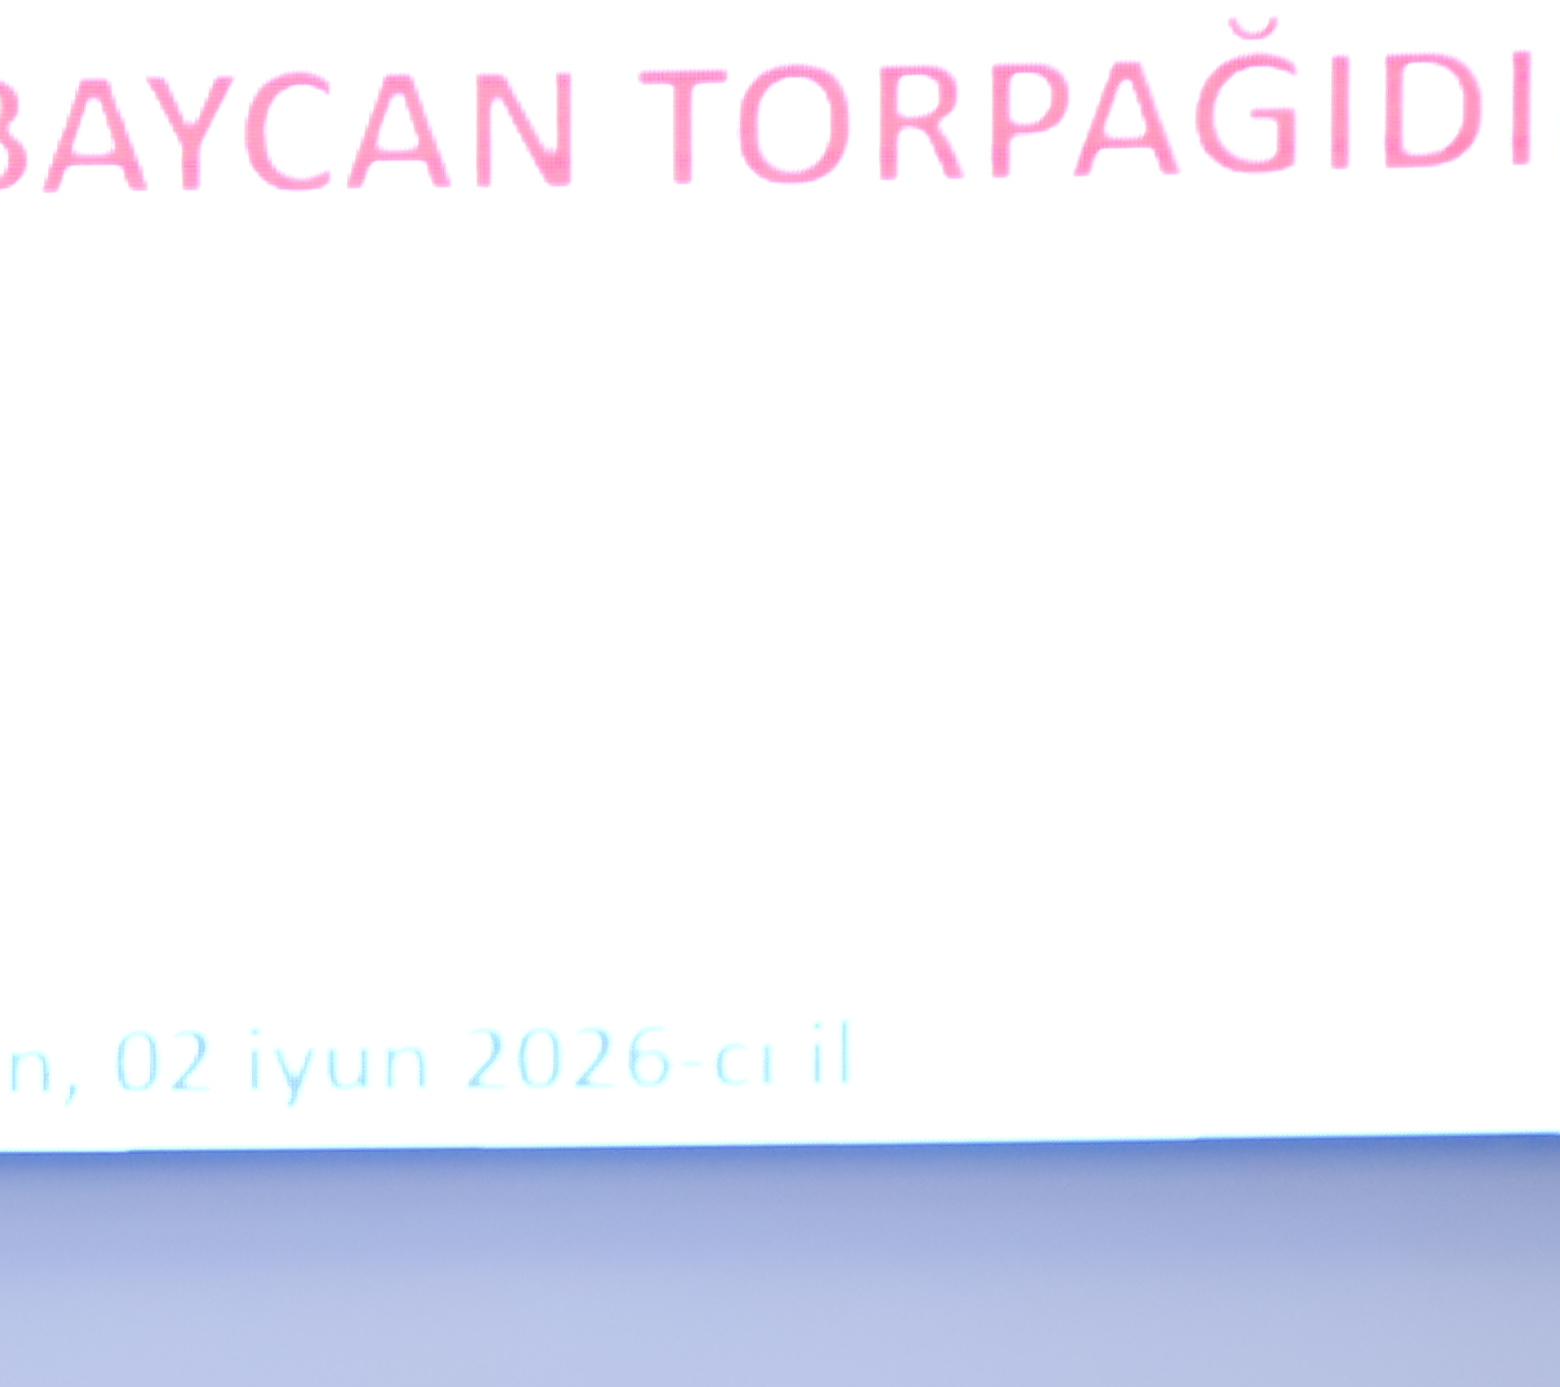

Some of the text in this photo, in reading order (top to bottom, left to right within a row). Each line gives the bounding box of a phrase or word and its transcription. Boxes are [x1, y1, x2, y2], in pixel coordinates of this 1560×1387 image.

[114, 1030, 210, 1092] 02
[250, 1027, 427, 1108] iyun
[466, 1025, 773, 1090] 2026-cı
[812, 1018, 851, 1085] il
